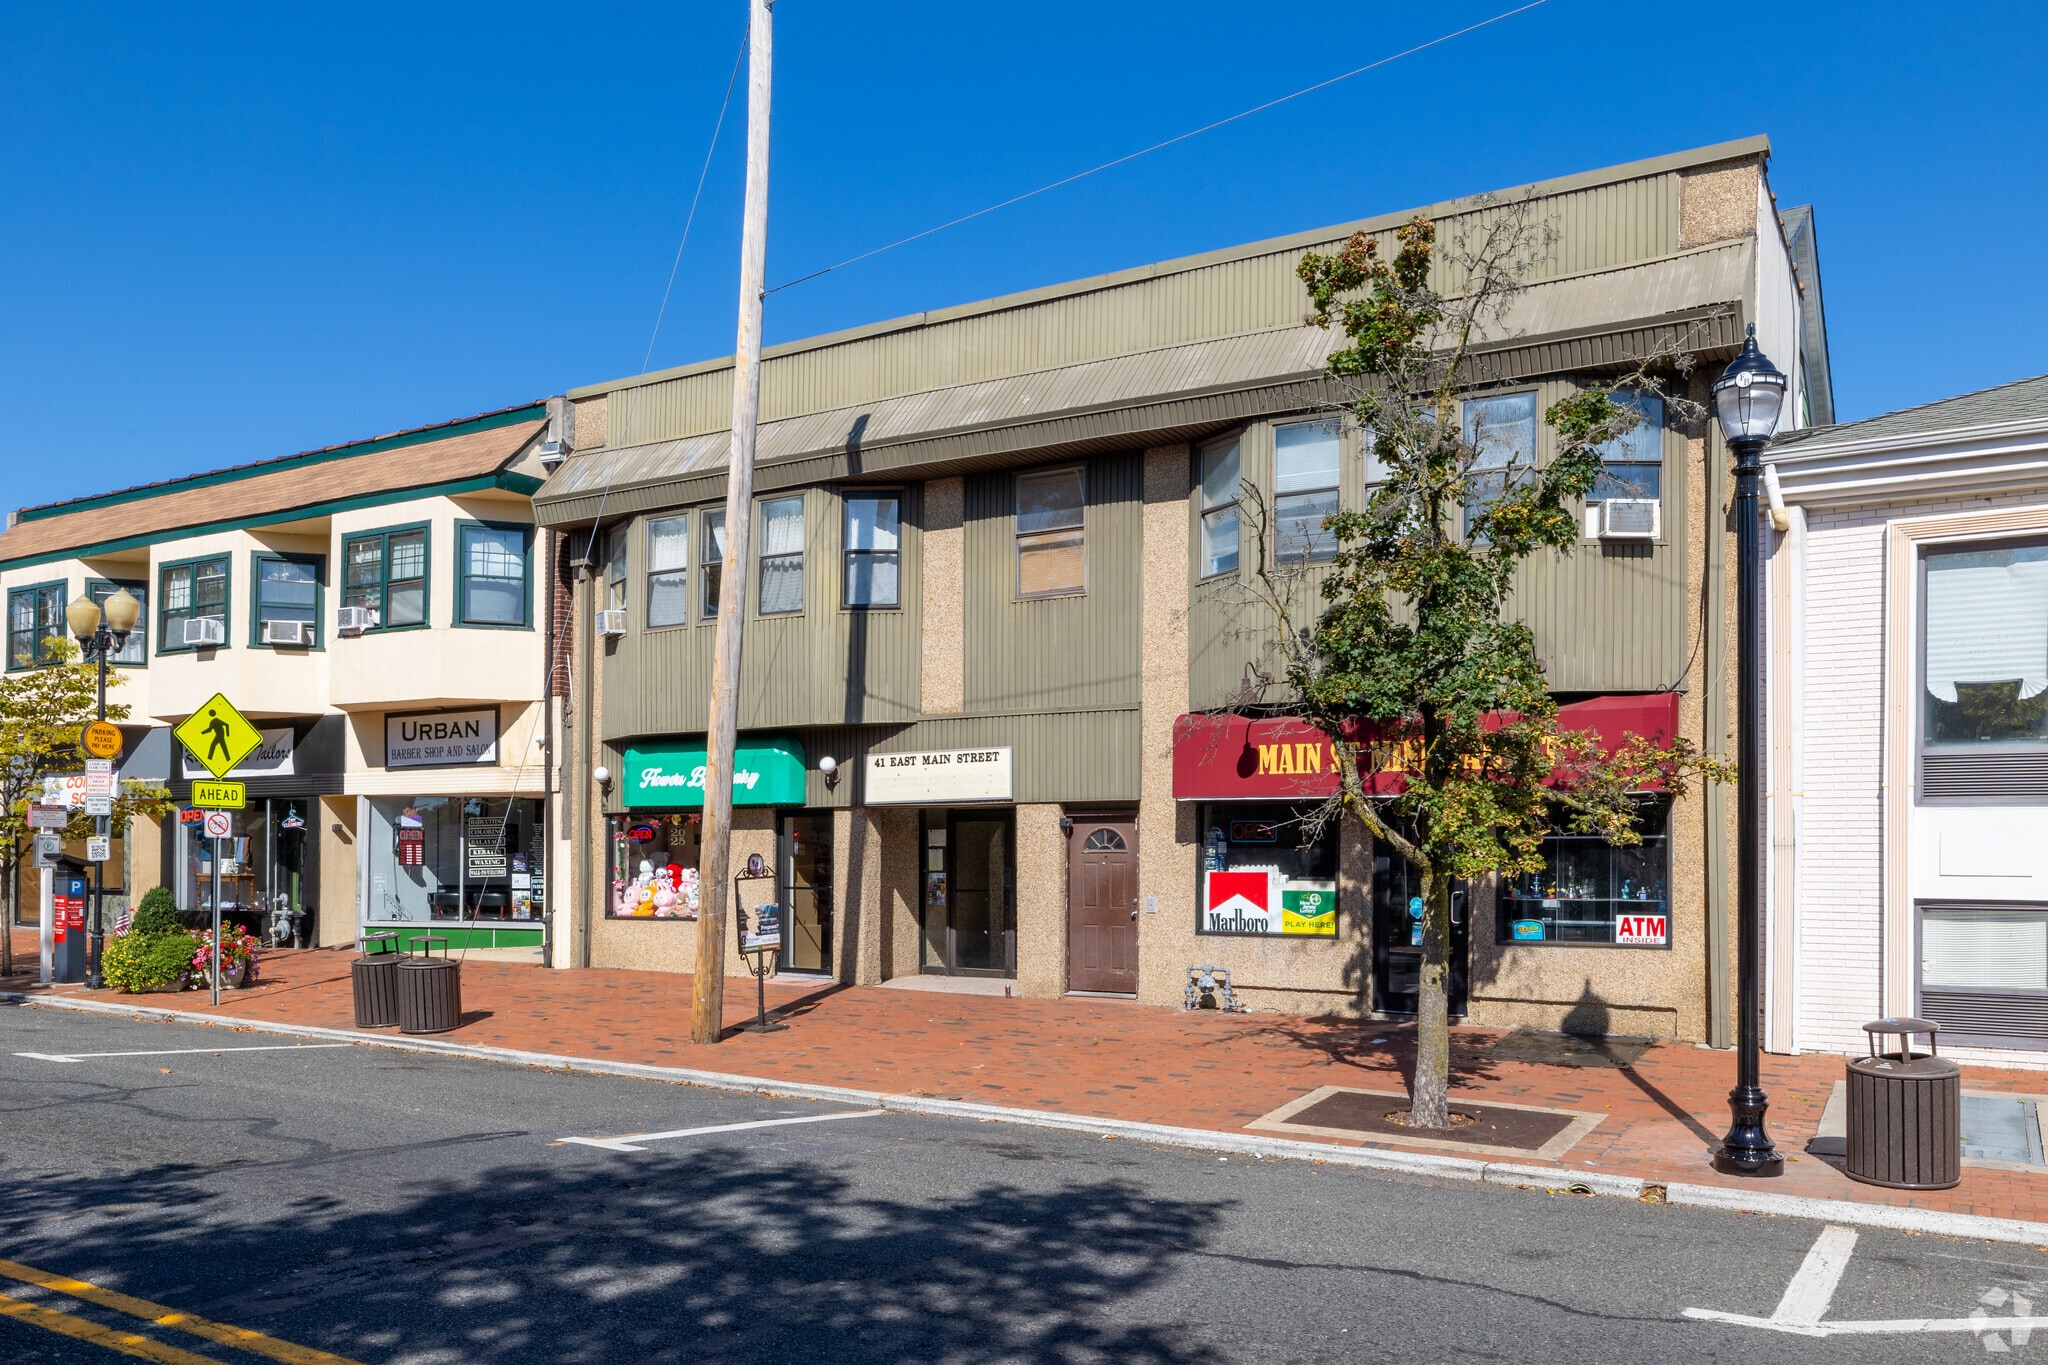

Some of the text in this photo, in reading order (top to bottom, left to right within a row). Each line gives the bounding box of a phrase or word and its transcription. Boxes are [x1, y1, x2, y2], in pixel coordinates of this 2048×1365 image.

[91, 728, 116, 737] PARKING
[401, 720, 480, 742] URBAN
[95, 735, 113, 743] PLEASE
[256, 744, 291, 761] Tailors
[391, 743, 492, 760] BARBER SHOP AND SALON
[1258, 743, 1322, 775] MAIN
[1370, 738, 1426, 772] MIN
[874, 751, 1000, 768] 41 EAST MAIN STREET
[639, 767, 687, 788] Flowers
[732, 769, 760, 790] aisy
[200, 788, 239, 801] AHEAD
[180, 809, 206, 823] OPEN
[628, 829, 654, 840] OPEN
[671, 828, 686, 837] 20
[671, 837, 686, 846] 25
[1209, 908, 1269, 932] Marlboro
[1308, 921, 1334, 929] HERE!
[1618, 917, 1665, 937] ATM
